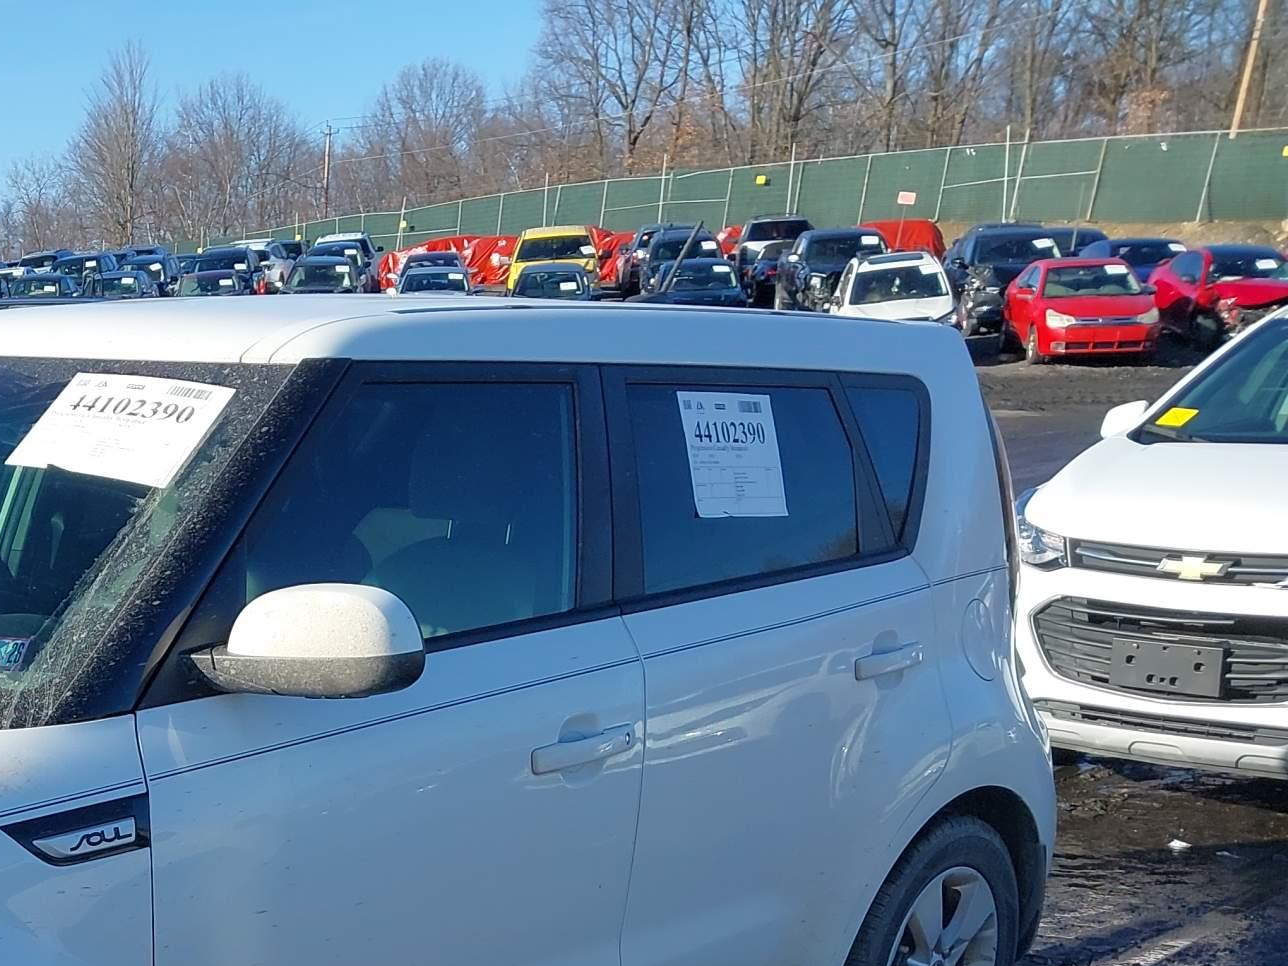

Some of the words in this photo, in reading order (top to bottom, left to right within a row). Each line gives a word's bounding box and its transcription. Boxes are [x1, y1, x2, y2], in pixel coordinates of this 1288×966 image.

[70, 394, 195, 424] 44102390
[694, 420, 766, 445] 44102390
[70, 826, 133, 852] SOUL
